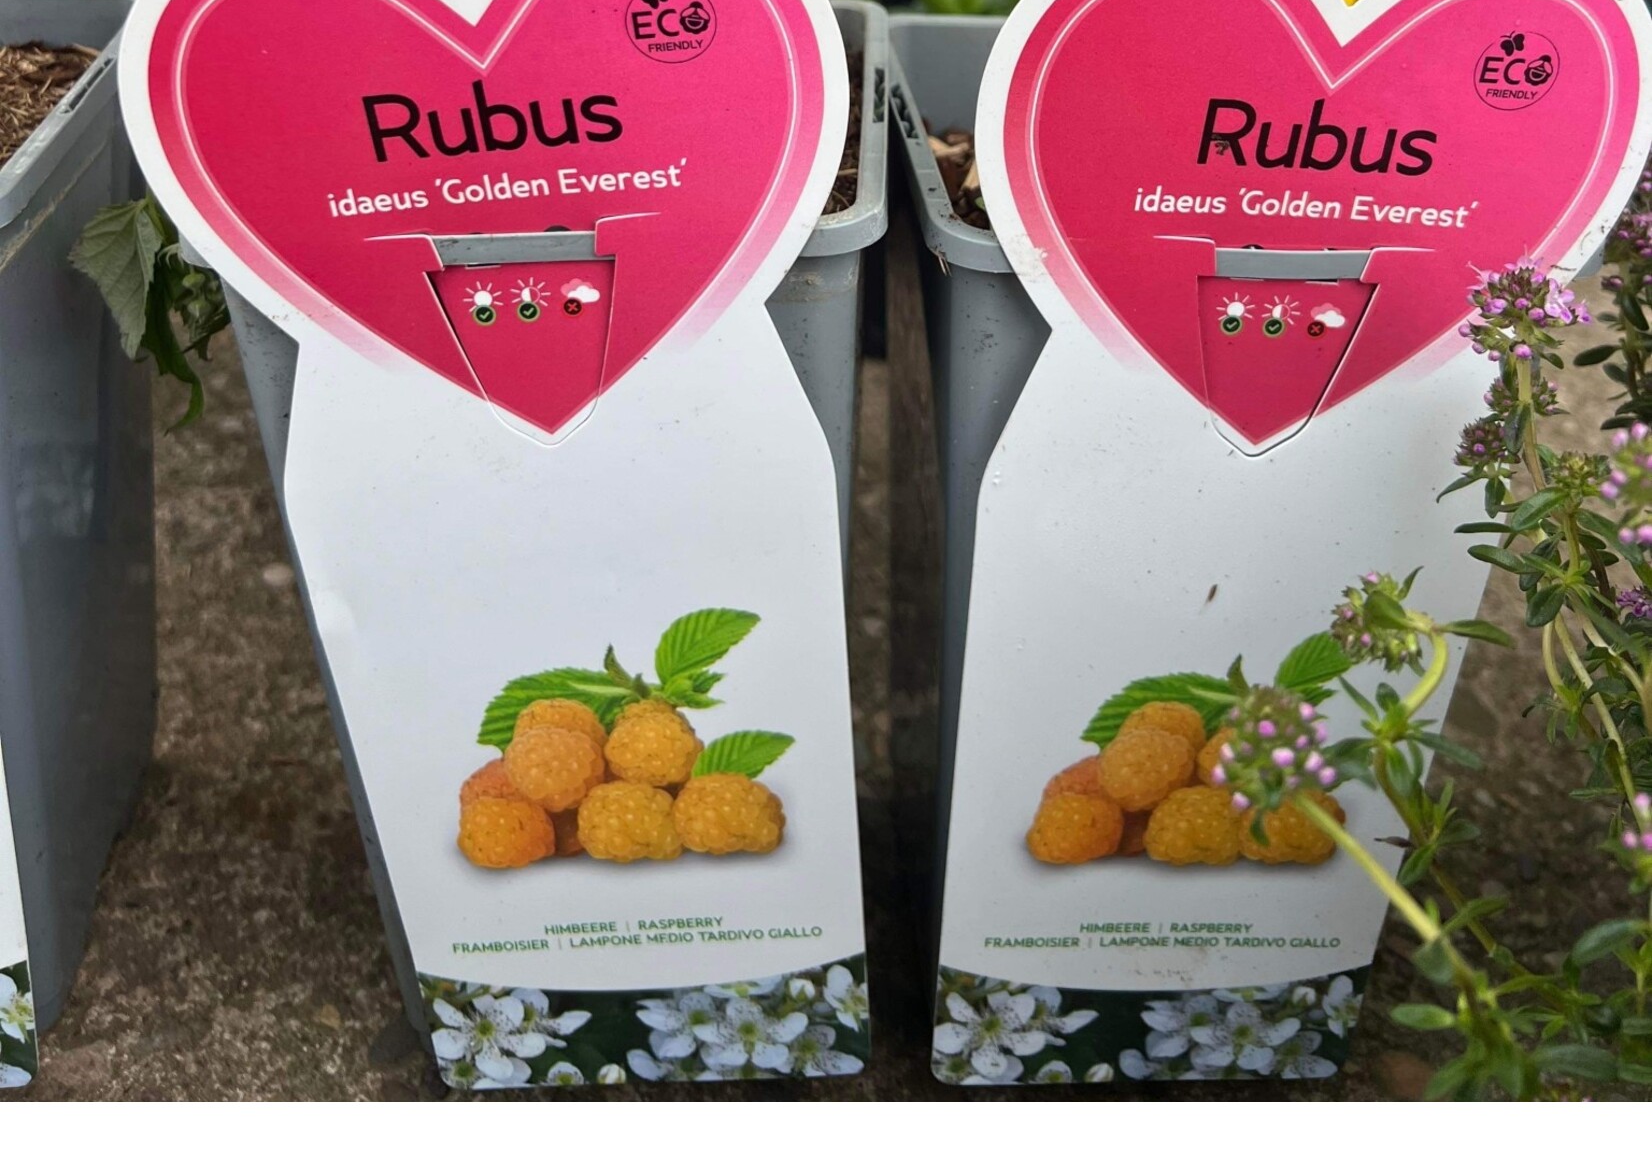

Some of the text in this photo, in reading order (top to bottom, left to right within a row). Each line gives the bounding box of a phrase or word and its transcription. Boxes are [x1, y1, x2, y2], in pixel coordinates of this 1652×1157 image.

[648, 39, 704, 53] FRIENDLY
[1485, 88, 1538, 100] FRIENDLY
[362, 79, 623, 162] Rubus
[1196, 98, 1438, 176] Rubus
[327, 158, 687, 217] idaeus 'Golden Everest'
[1134, 186, 1479, 229] idaeus 'Golden Everest'
[544, 916, 724, 935] HIMBEERE RASPBERRY
[1079, 922, 1254, 934] HIMBEERE RASPBERRY
[452, 925, 823, 954] FRAMBOISIER LAMPONE MEDIO TARDIVO GIALLO
[984, 936, 1342, 949] FRAMBOISIER LAMPONE MEDIO TARDIVO GIALLO
